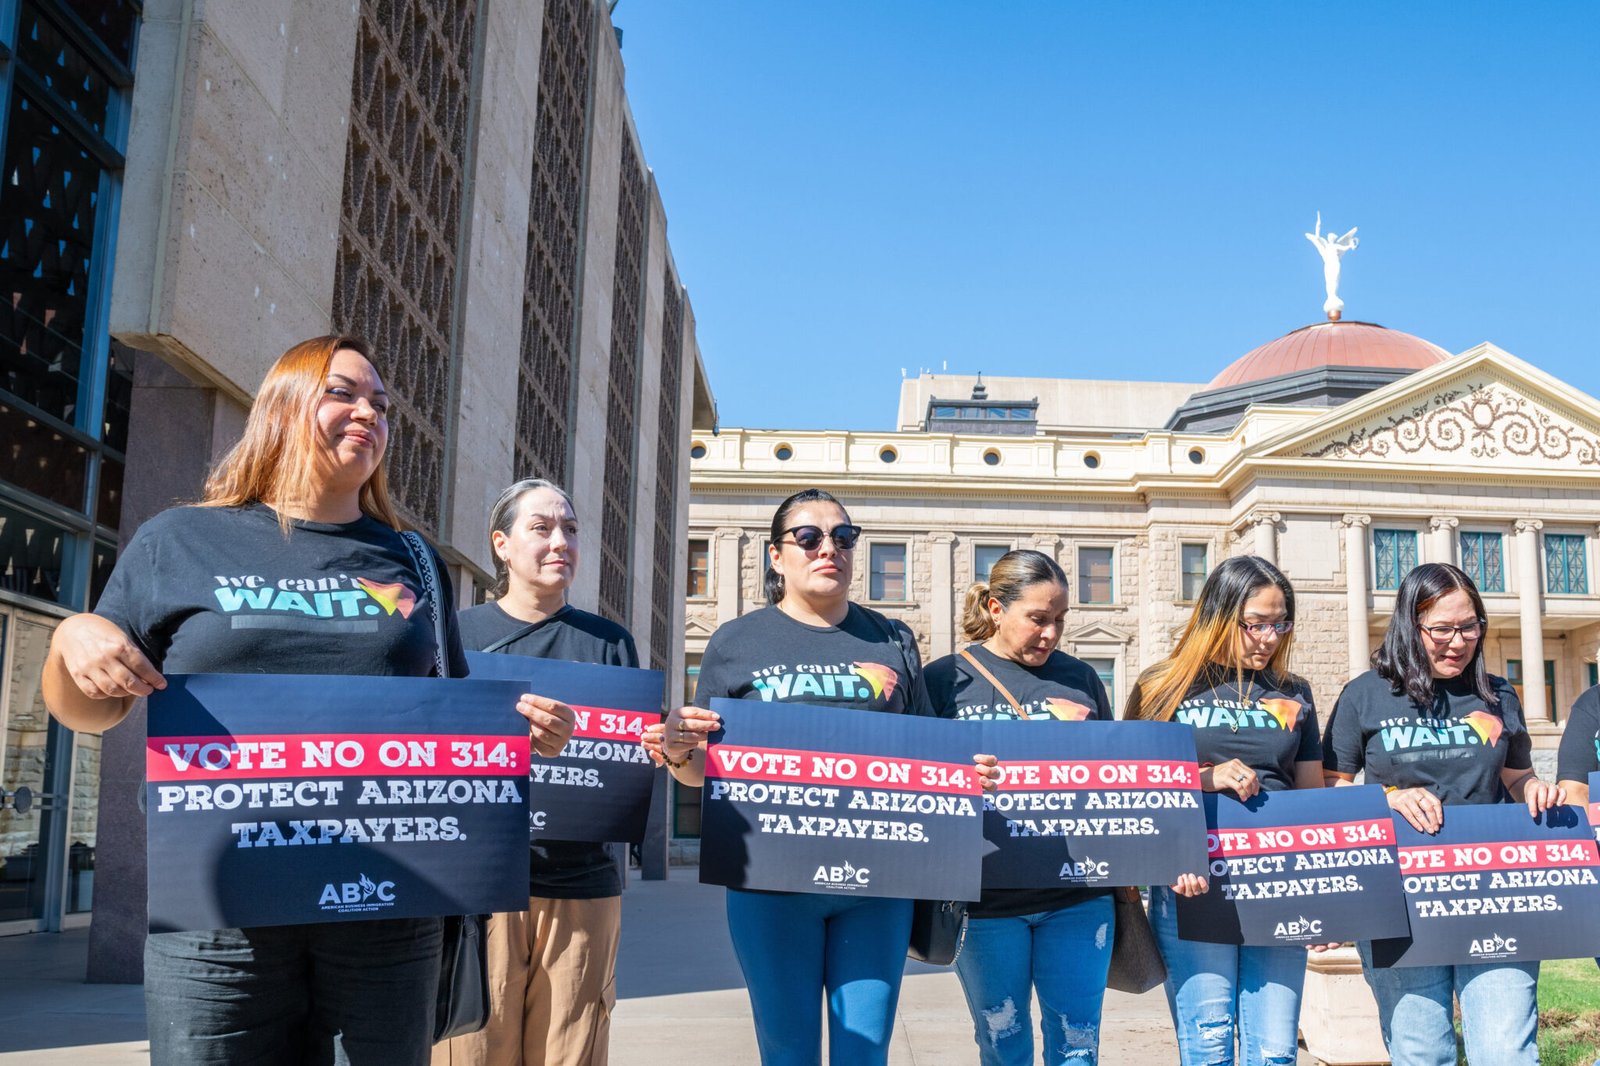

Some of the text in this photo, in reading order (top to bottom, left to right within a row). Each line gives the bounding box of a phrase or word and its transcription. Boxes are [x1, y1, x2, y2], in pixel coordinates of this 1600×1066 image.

[214, 575, 265, 588] we
[214, 587, 380, 617] WAIT.
[752, 664, 787, 678] we
[752, 673, 869, 702] WAIT.
[958, 704, 988, 716] we
[1176, 707, 1277, 728] WAIT.
[1380, 716, 1409, 728] we
[1380, 725, 1478, 752] WAIT.
[164, 740, 517, 772] VOTE NO ON 314:
[560, 740, 650, 764] IZONA
[530, 764, 604, 788] YERS.
[718, 750, 972, 789] VOTE NO ON 314:
[991, 764, 1192, 785] OTE NO ON 314:
[158, 779, 522, 812] PROTECT ARIZONA
[711, 781, 976, 817] PROTECT ARIZONA
[982, 791, 1199, 811] ROTECT ARIZONA
[231, 816, 467, 848] TAXPAYERS.
[758, 813, 929, 843] TAXPAYERS.
[1006, 817, 1160, 837] TAXPAYERS.
[1207, 823, 1387, 852] OTE NO ON 314:
[1210, 848, 1394, 877] OTECT ARIZONA
[1398, 844, 1590, 870] OTE NO ON 314:
[1221, 875, 1363, 900] TAXPAYERS.
[1403, 868, 1599, 894] OTECT ARIZONA
[1415, 894, 1562, 918] TAXPAYERS.
